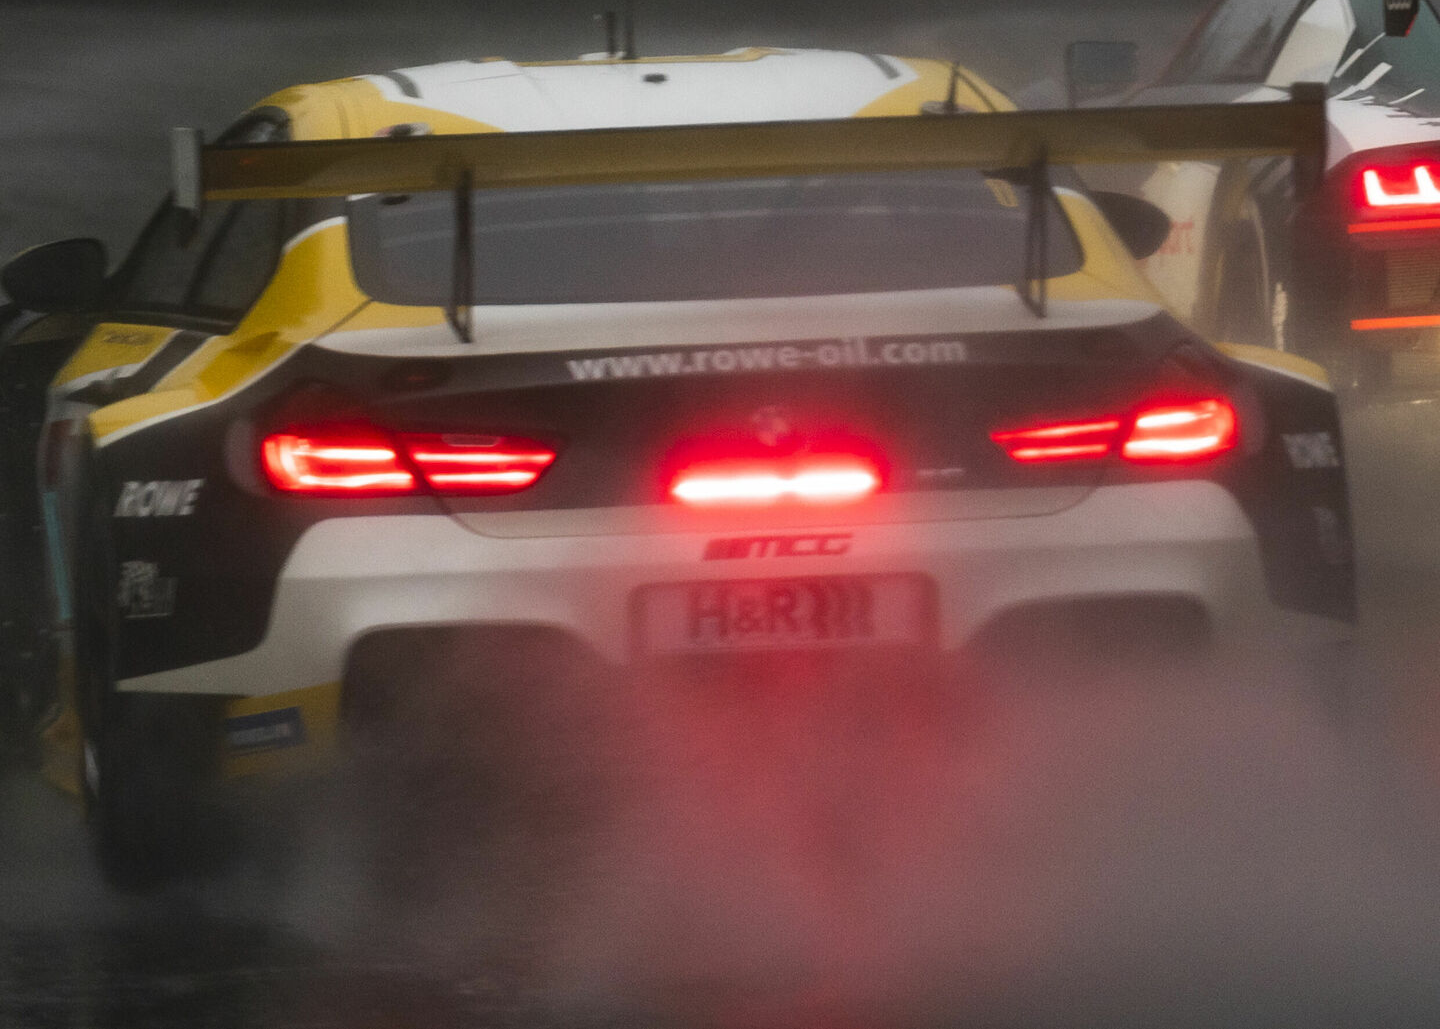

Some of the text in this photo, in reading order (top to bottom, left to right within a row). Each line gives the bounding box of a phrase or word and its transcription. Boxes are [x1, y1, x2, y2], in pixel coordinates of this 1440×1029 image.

[567, 337, 967, 380] www.rowe-oil.com
[113, 479, 206, 518] ROWE
[688, 584, 800, 642] H&R
